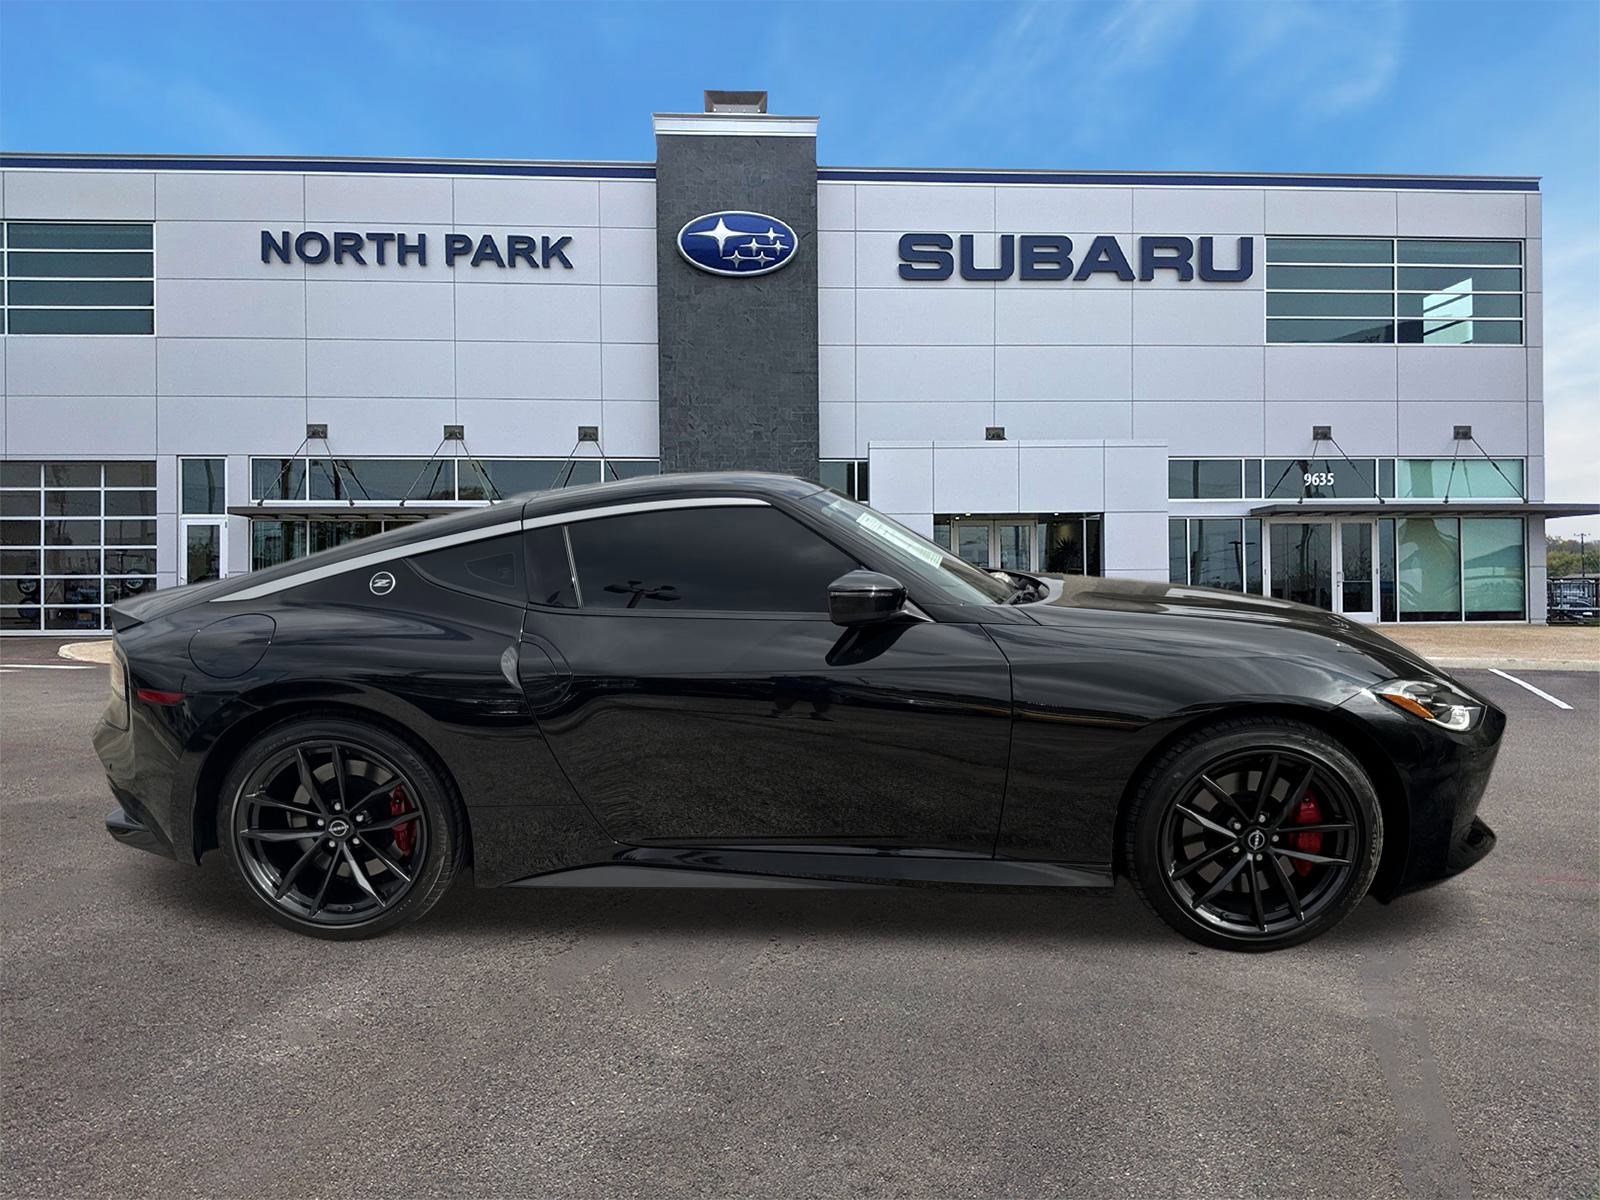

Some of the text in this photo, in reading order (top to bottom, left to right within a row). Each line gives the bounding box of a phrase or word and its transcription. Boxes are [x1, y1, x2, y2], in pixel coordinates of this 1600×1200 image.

[260, 230, 574, 269] NORTH PARK
[898, 234, 1254, 283] SUBARU
[1303, 472, 1335, 486] 9635
